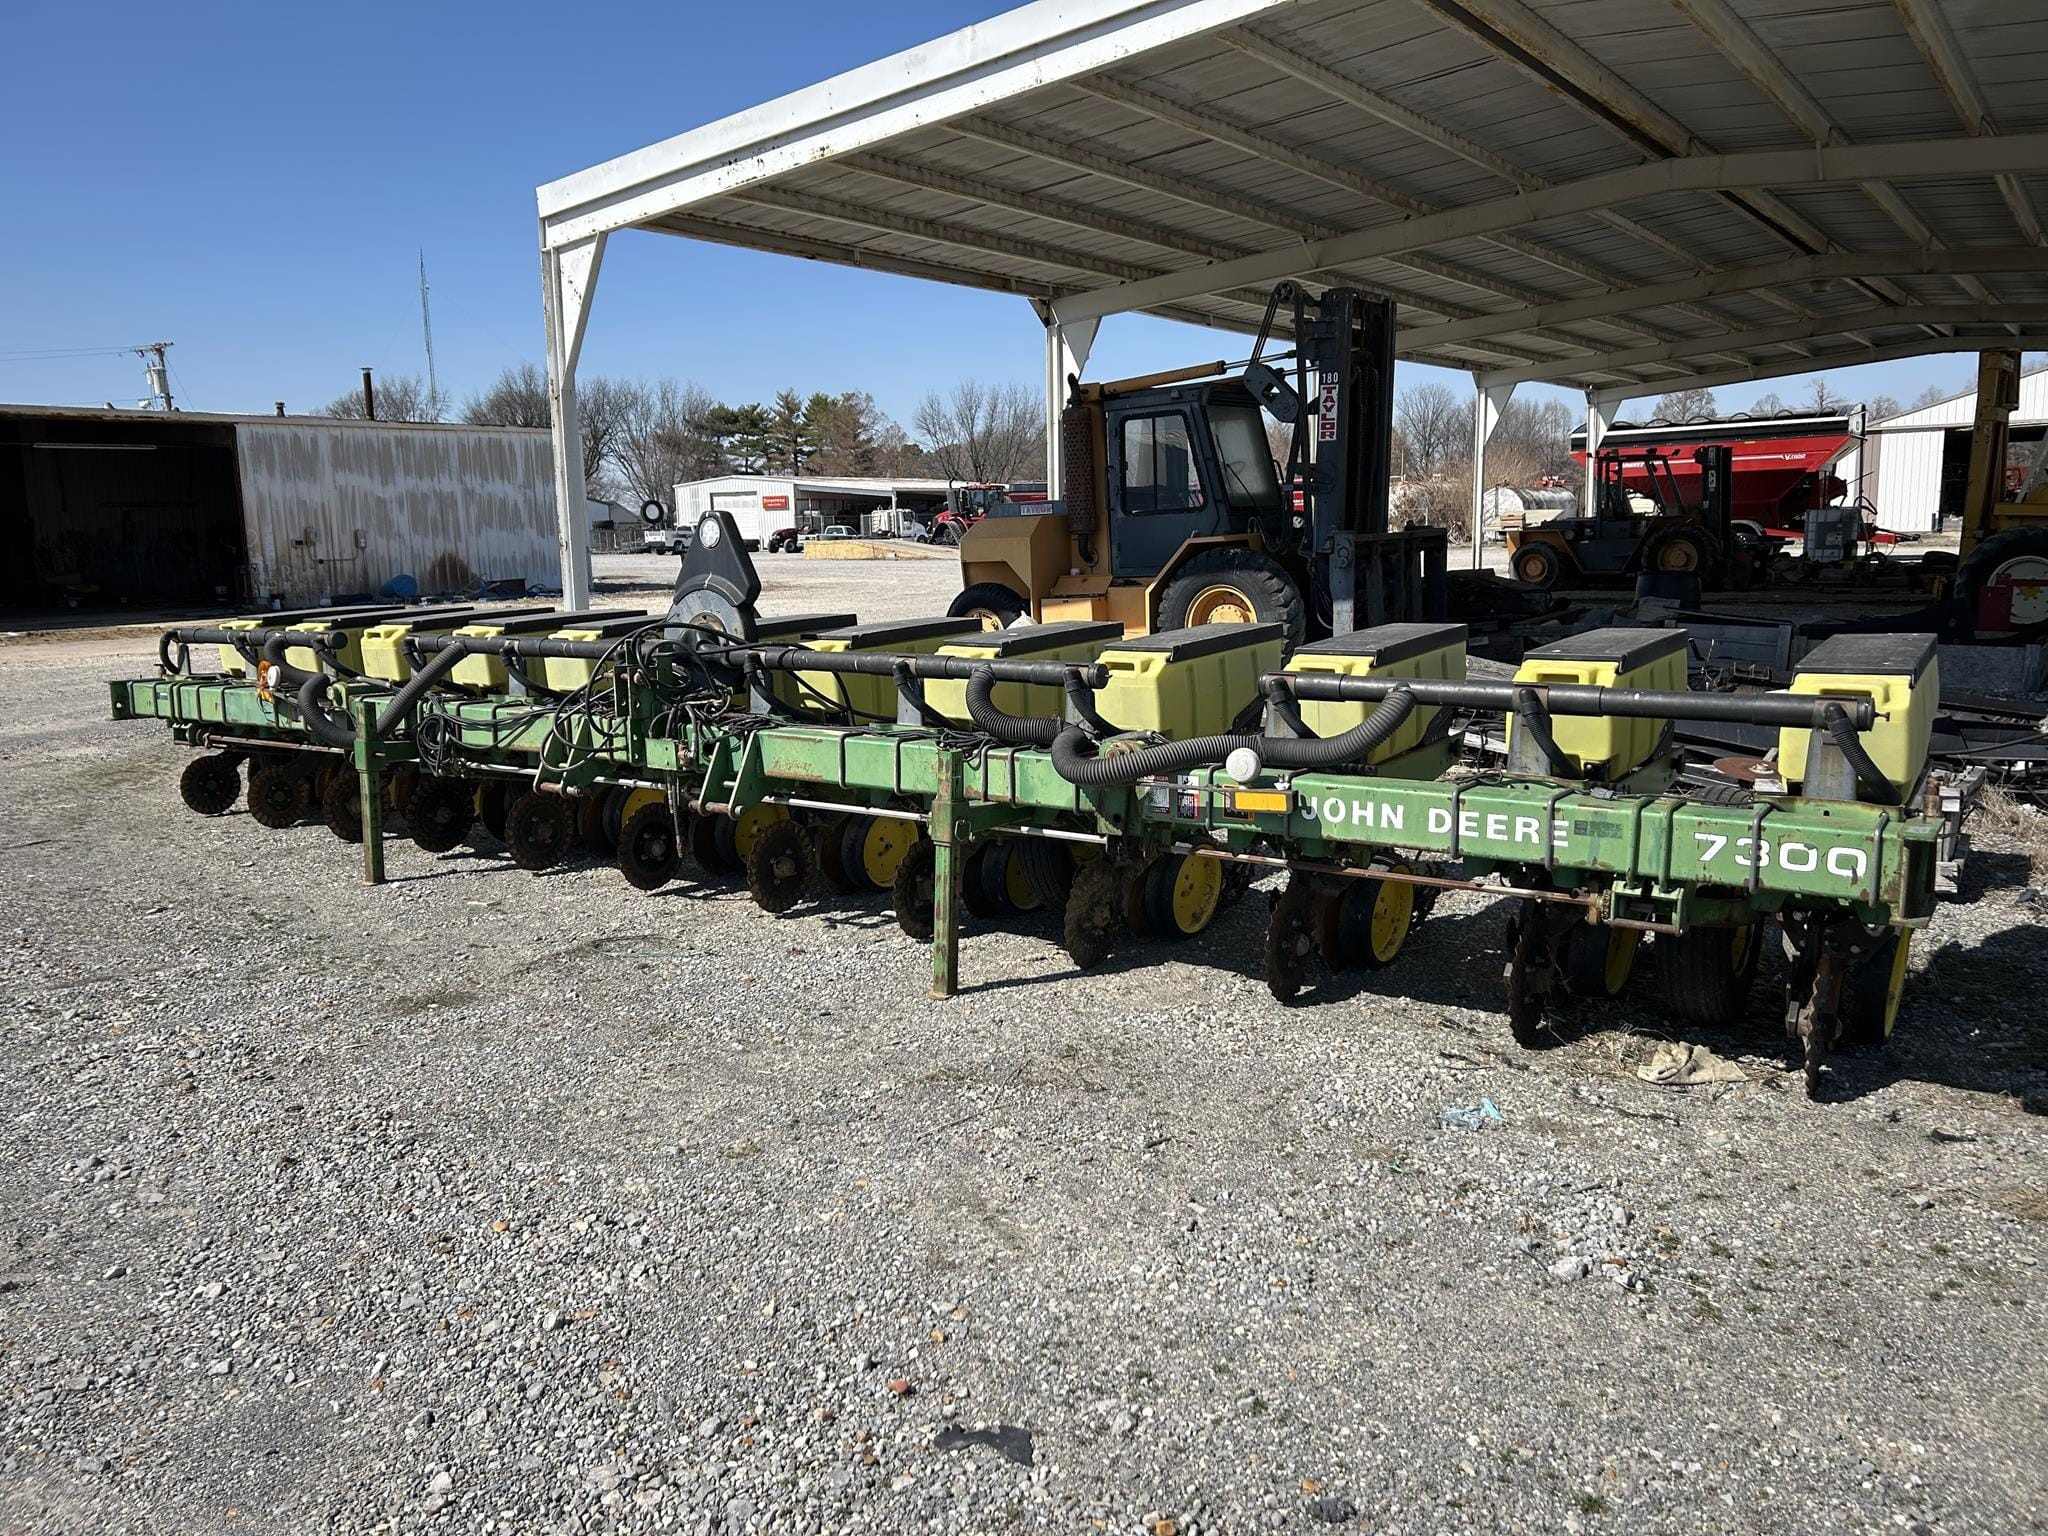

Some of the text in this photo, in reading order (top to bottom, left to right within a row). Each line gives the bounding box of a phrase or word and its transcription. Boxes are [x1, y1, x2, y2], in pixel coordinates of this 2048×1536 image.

[1322, 372, 1339, 384] 180
[1320, 386, 1337, 440] TAYLOR
[1300, 796, 1405, 829] JOHN
[1427, 806, 1570, 848] DEERE
[1693, 832, 1868, 878] 7300
